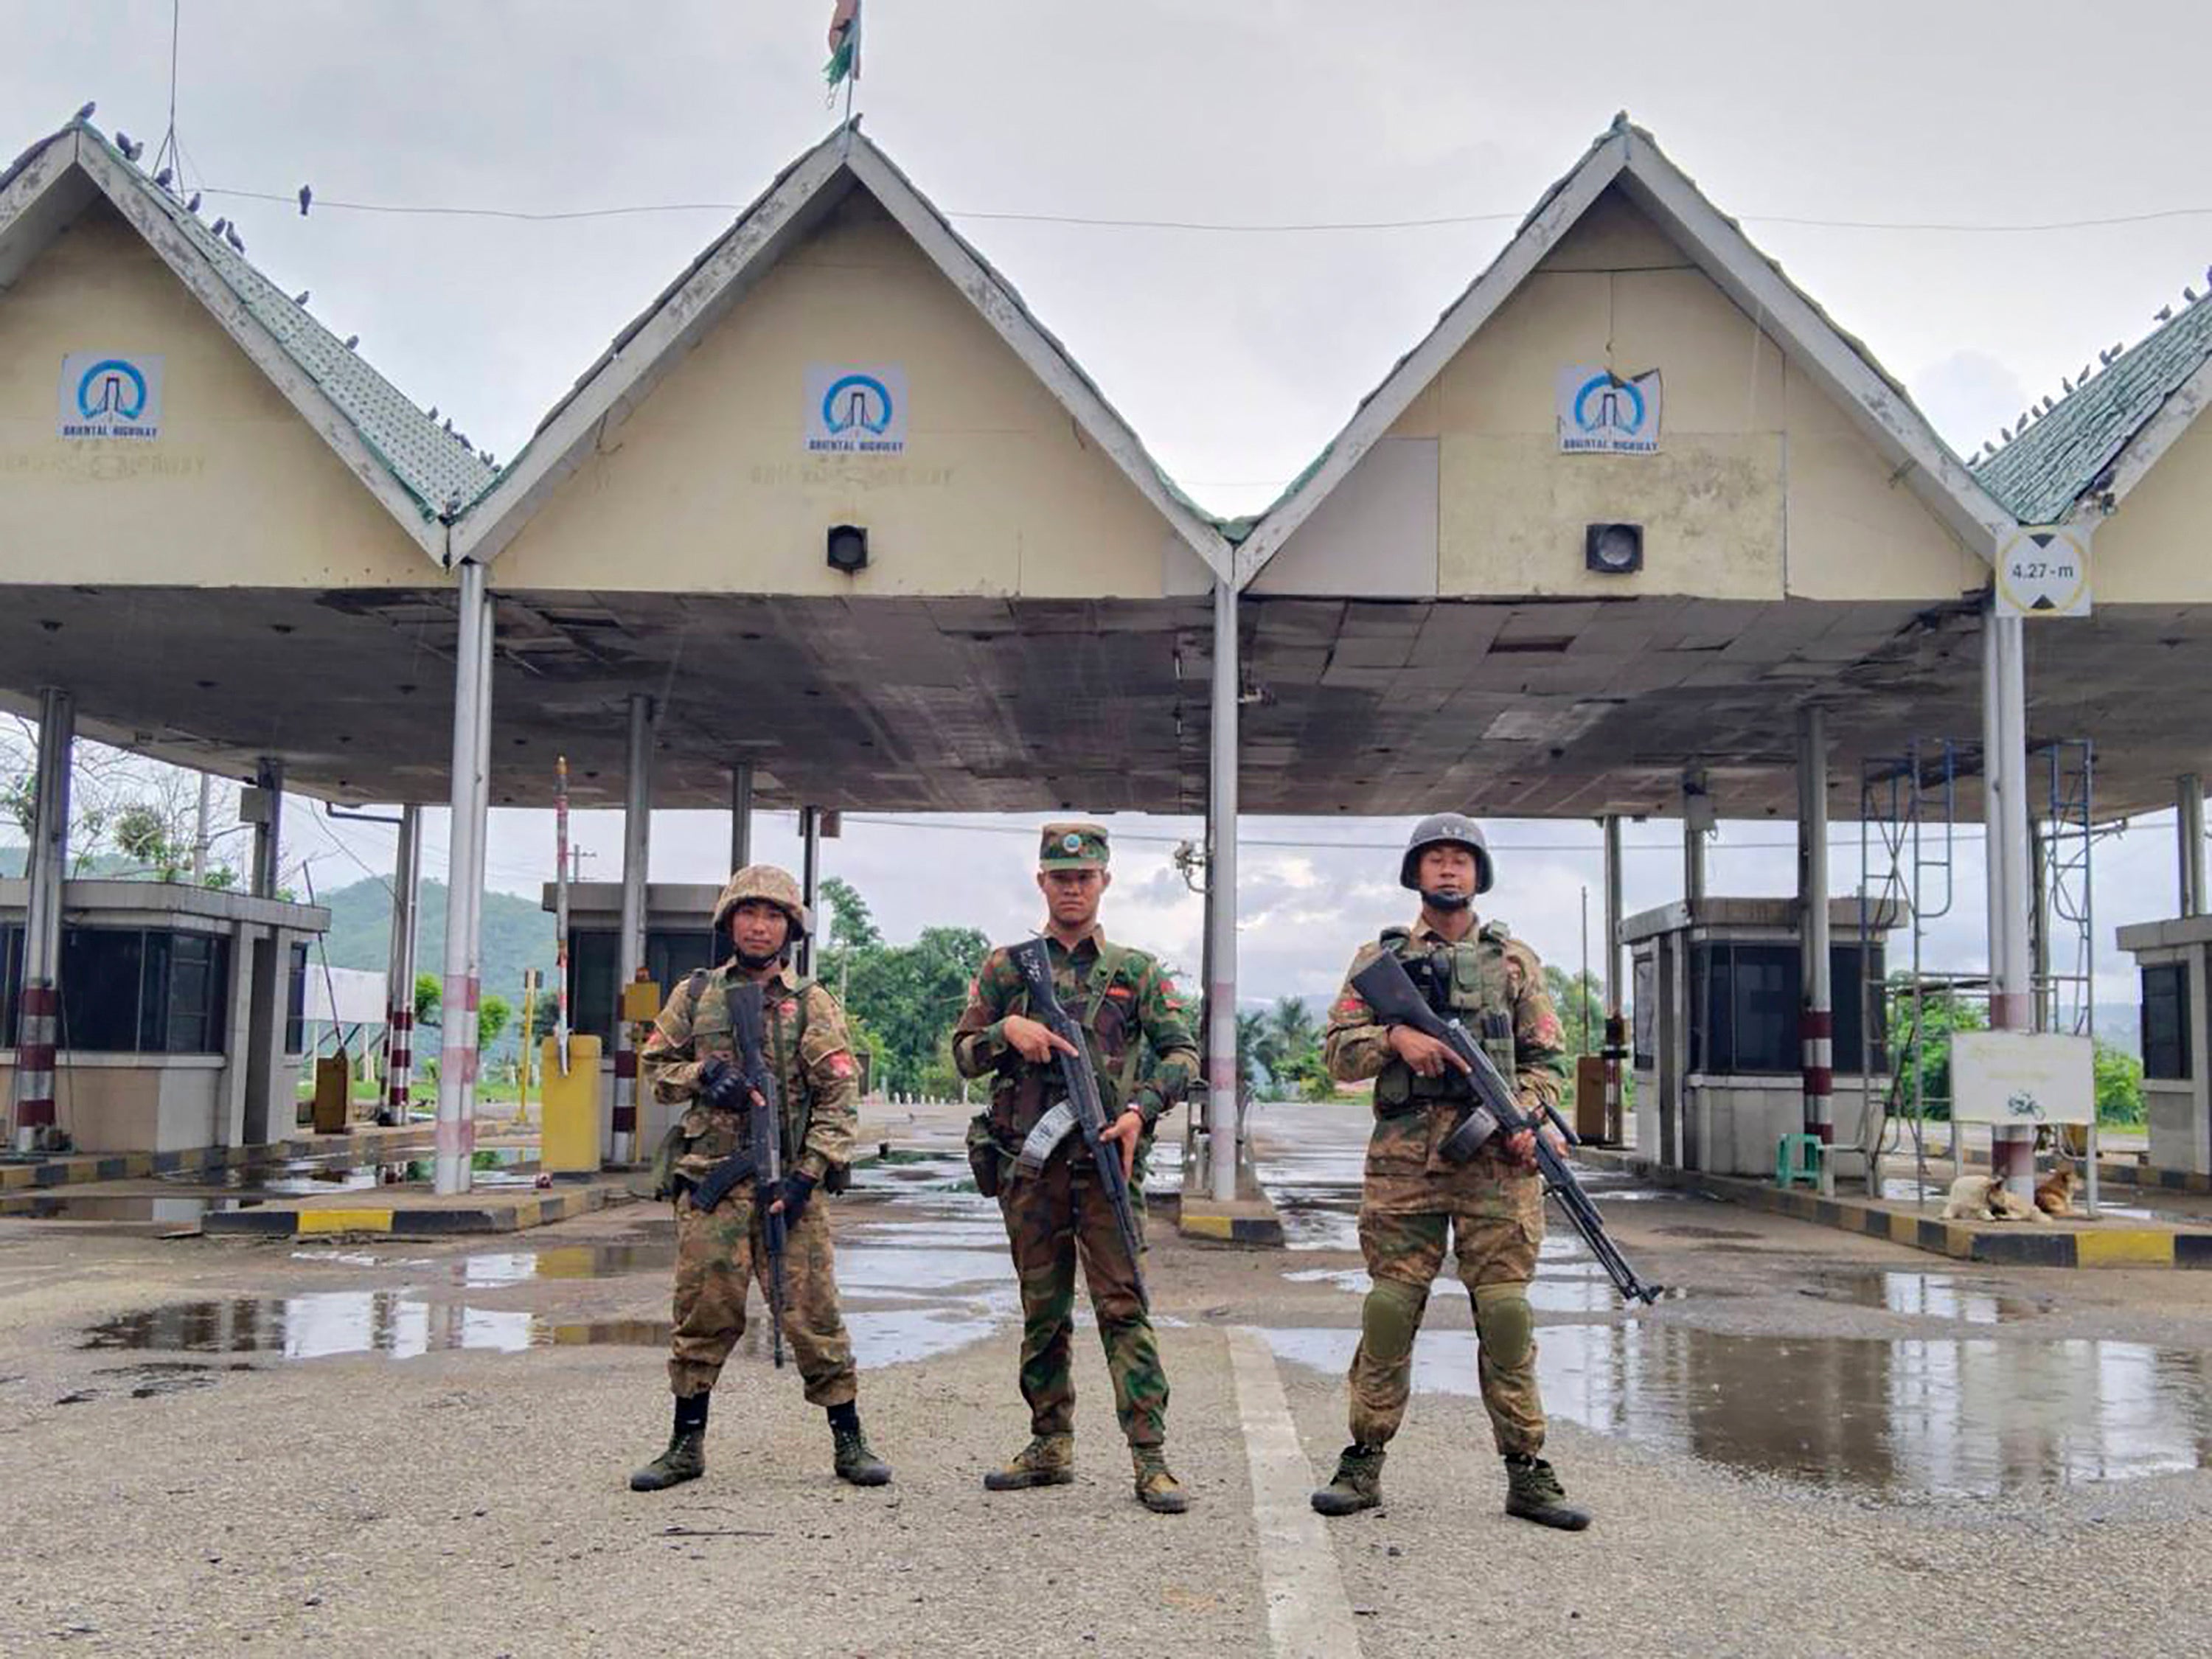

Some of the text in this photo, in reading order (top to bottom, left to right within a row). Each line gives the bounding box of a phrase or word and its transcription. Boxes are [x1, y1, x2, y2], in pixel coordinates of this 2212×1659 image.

[63, 425, 156, 437] ORIENTAL HIGHWAY
[810, 439, 903, 451] ORIENTAL HIGHWAY
[1563, 439, 1658, 451] ORIENTAL HIGHWAY
